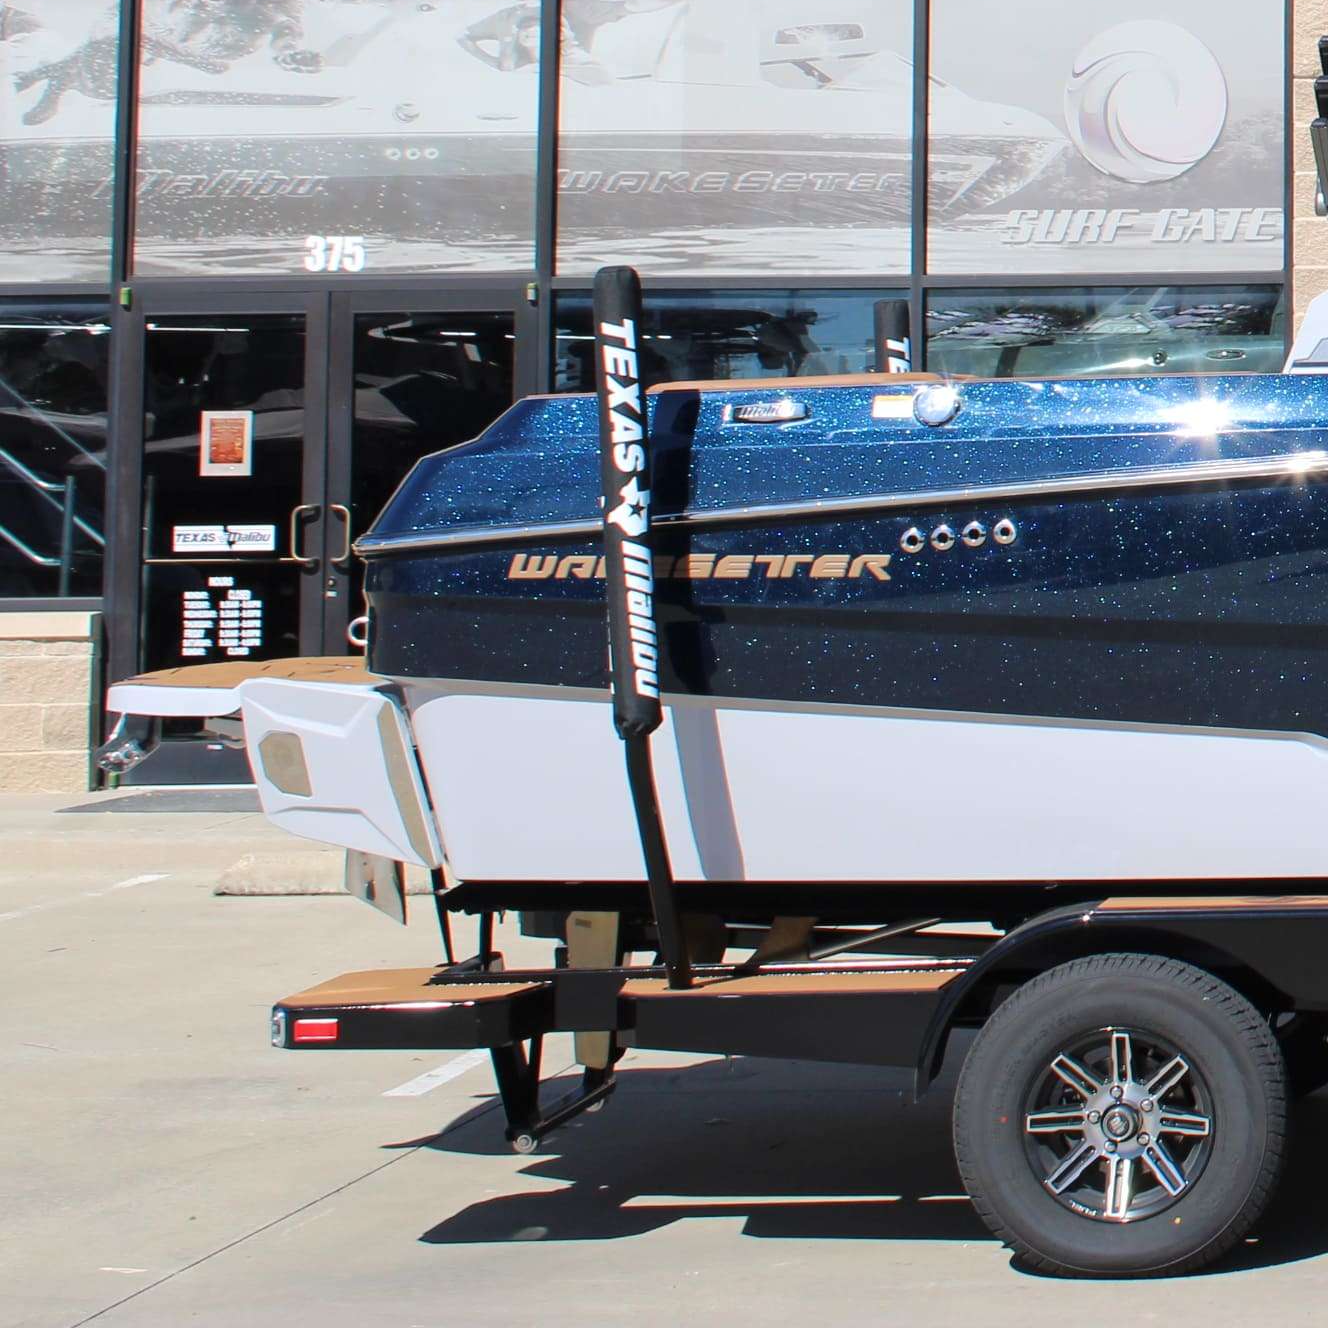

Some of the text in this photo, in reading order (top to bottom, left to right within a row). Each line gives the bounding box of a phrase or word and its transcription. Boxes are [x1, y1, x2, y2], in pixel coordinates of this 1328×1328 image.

[1000, 207, 1284, 243] SURF GATE
[304, 235, 366, 273] 375
[601, 318, 645, 473] TEXAS
[176, 531, 271, 543] TEXAS Malibu
